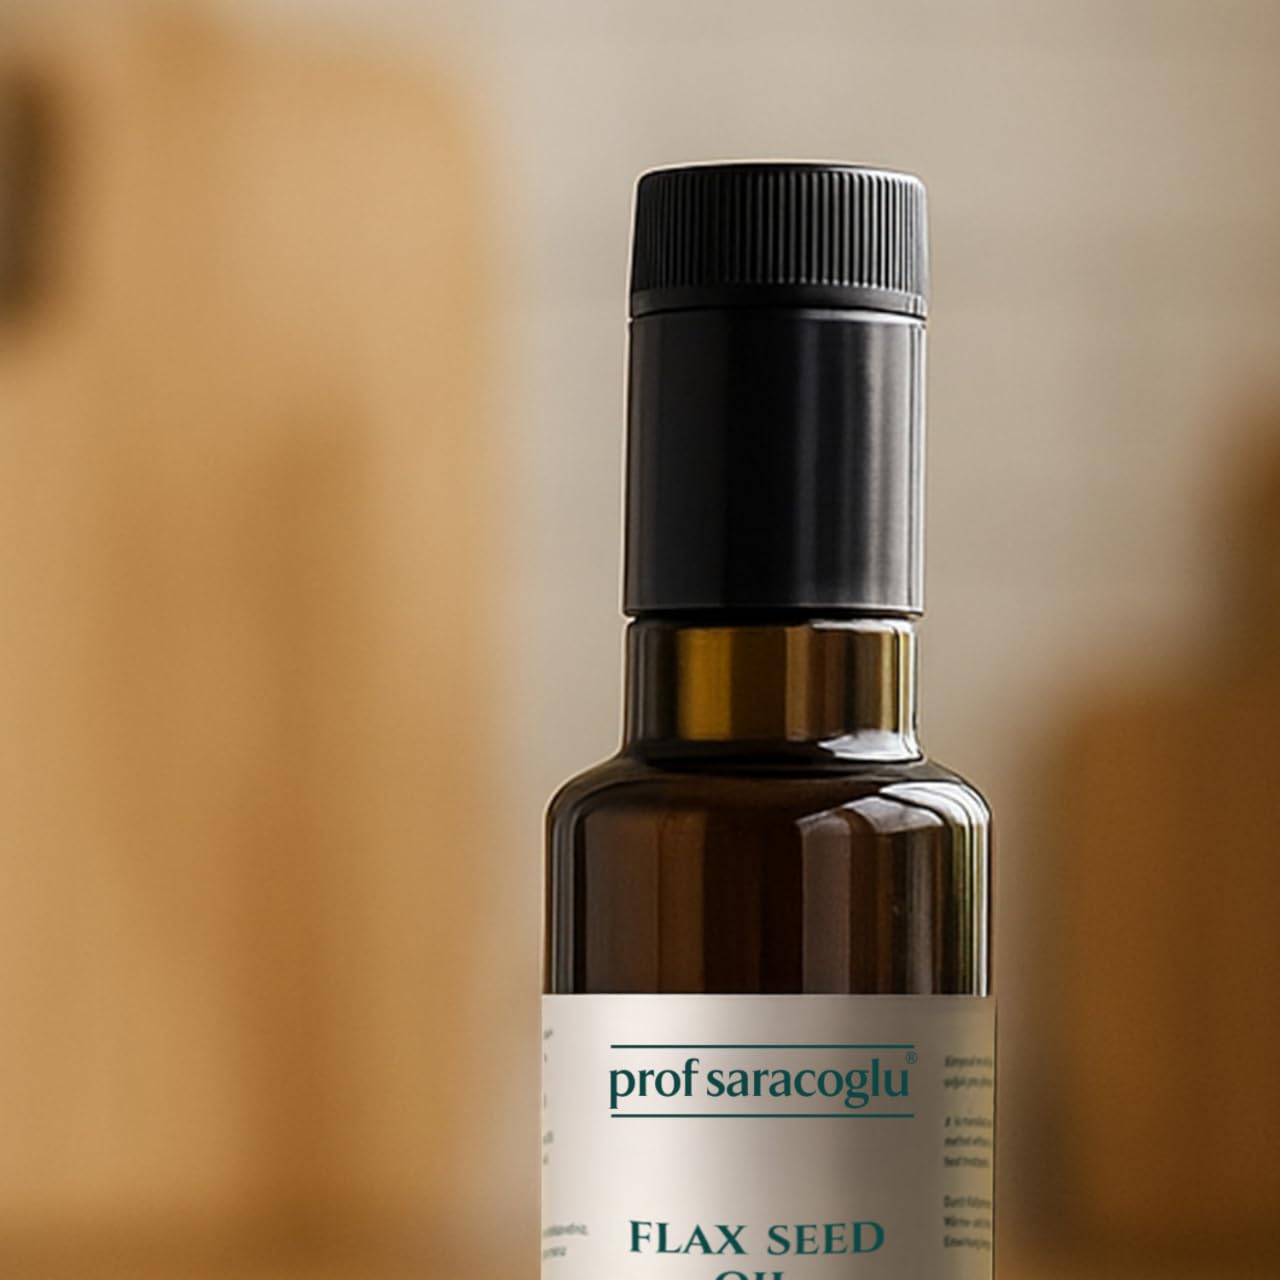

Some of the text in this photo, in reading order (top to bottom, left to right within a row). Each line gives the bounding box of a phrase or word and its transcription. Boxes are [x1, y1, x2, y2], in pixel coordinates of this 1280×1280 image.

[609, 1057, 700, 1110] prof
[629, 1219, 749, 1256] FLAX
[767, 1220, 885, 1256] SEED
